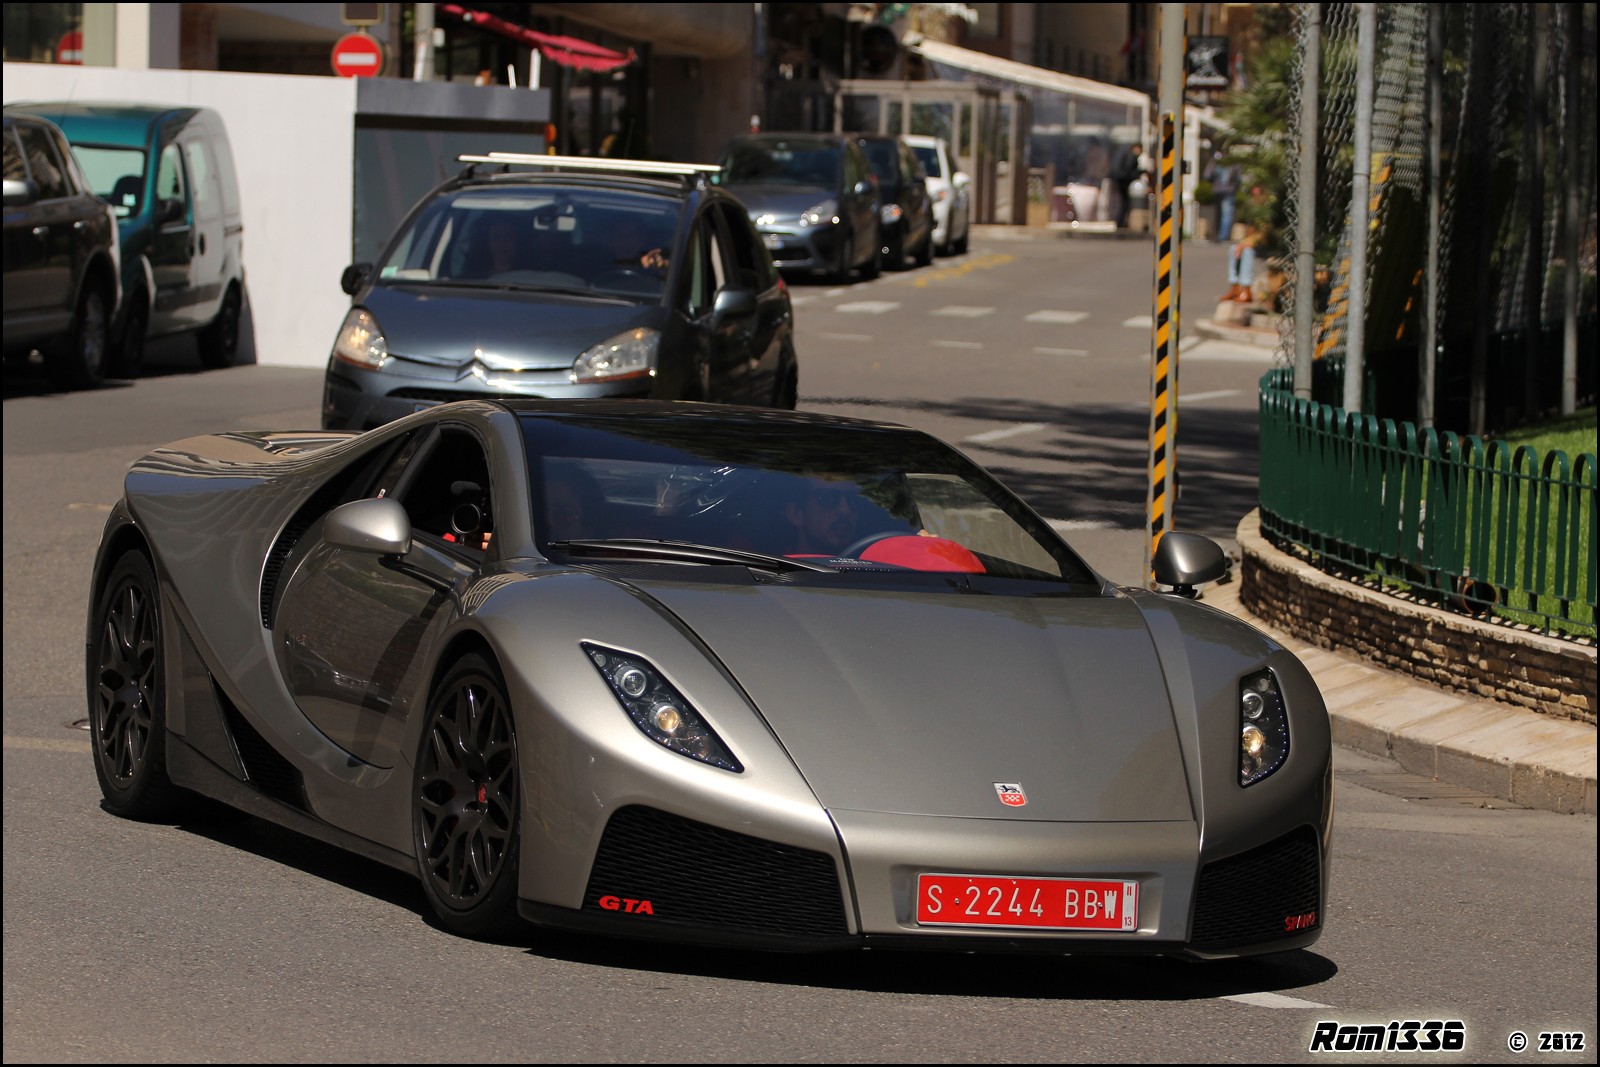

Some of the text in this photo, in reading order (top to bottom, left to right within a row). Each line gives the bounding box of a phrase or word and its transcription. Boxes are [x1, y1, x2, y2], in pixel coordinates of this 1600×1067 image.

[599, 895, 654, 915] GTA
[927, 884, 1117, 919] S 2244 BBW
[1124, 916, 1132, 926] 13
